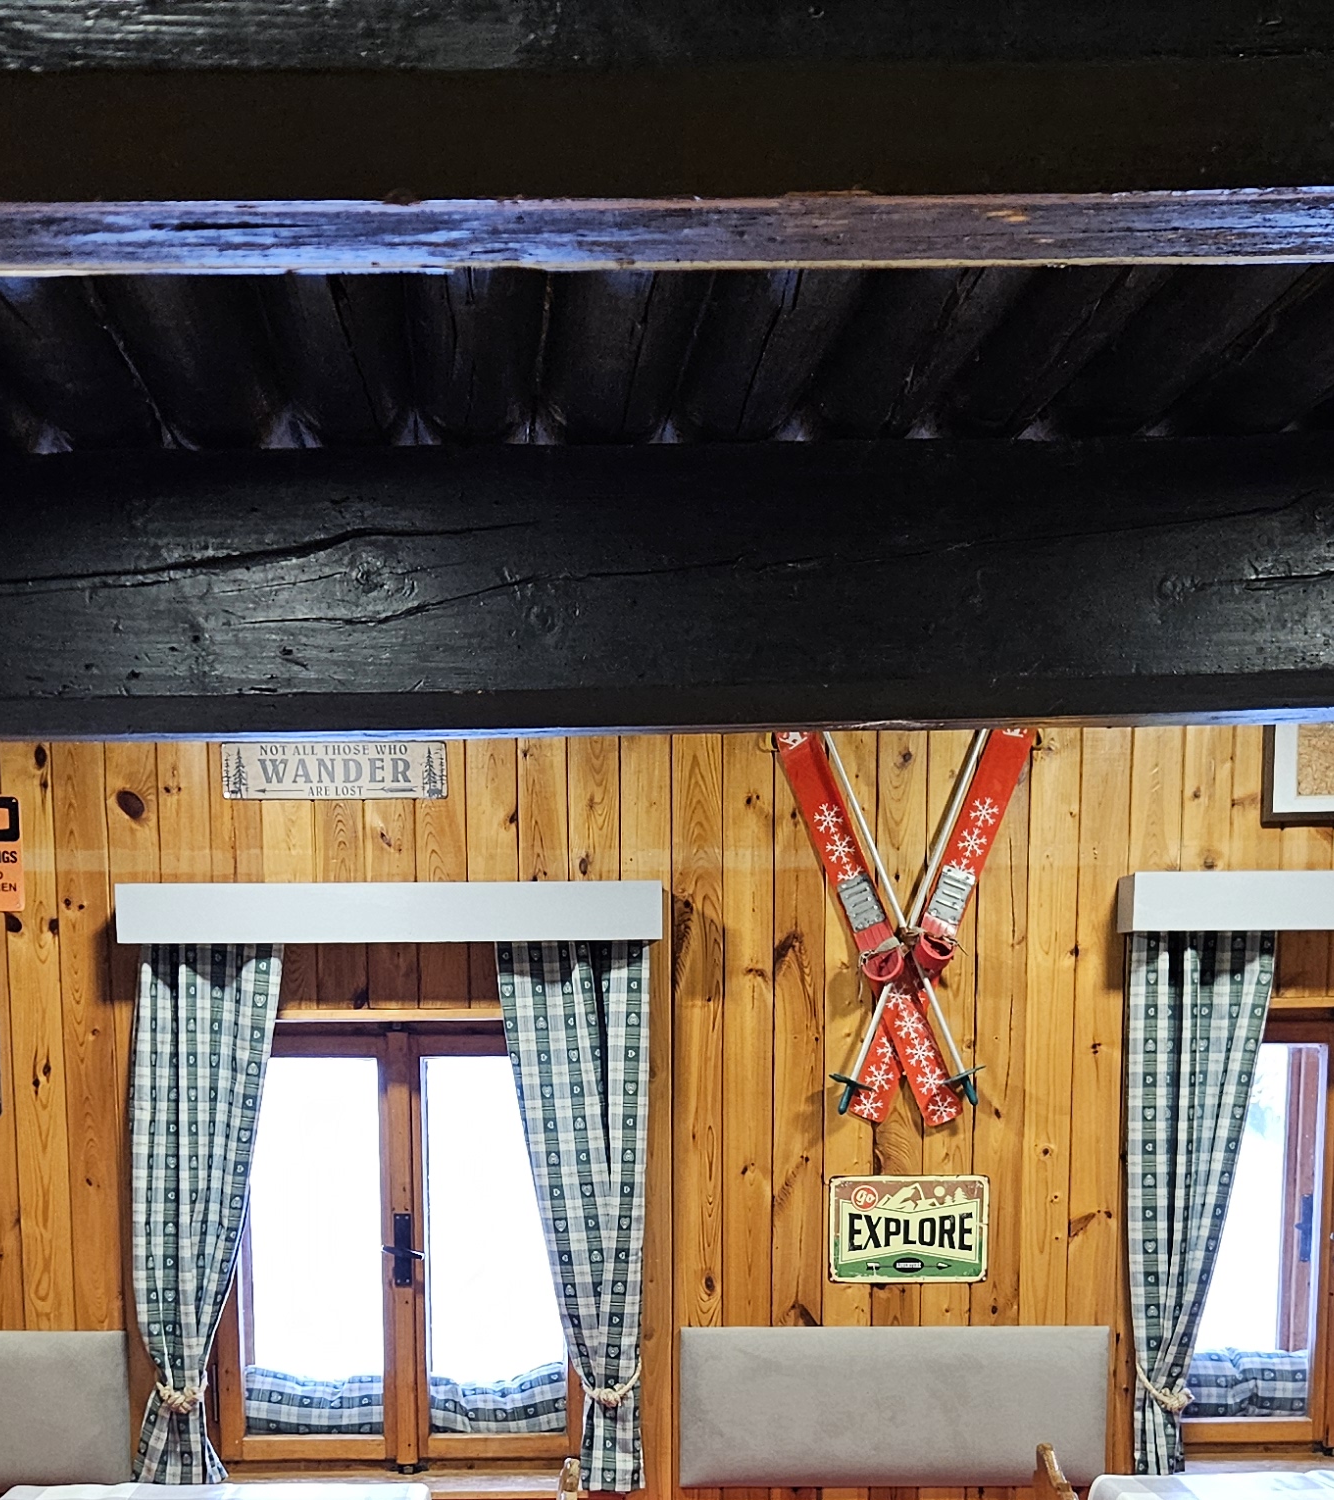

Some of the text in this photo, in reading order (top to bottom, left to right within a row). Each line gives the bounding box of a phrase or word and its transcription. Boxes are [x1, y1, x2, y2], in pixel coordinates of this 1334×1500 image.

[260, 743, 408, 756] NOT ALL THOSE WHO
[258, 757, 411, 784] WANDER
[308, 785, 364, 797] ARE LOST
[856, 1188, 876, 1206] go
[847, 1211, 974, 1252] EXPLORE
